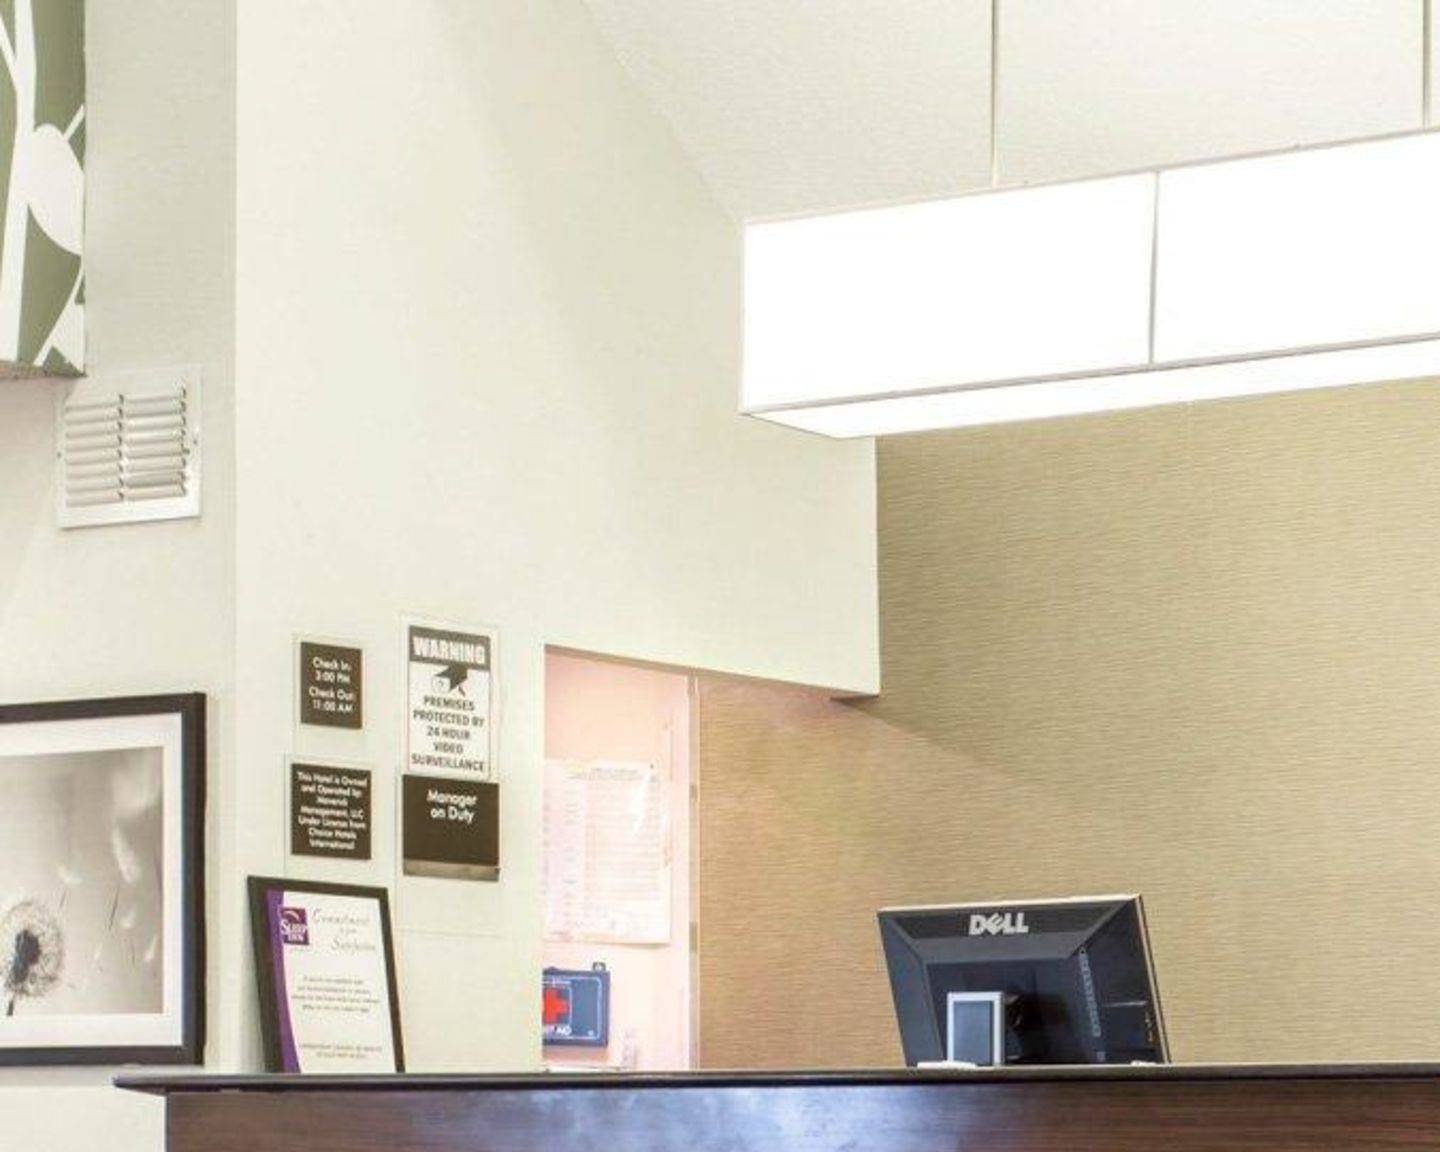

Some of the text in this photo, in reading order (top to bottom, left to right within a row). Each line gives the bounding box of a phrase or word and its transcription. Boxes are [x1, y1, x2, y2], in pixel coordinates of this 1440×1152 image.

[412, 634, 487, 665] WARNING
[423, 695, 476, 711] PREMISES
[413, 709, 485, 727] PROTECTED BY
[426, 725, 471, 739] 24 HOUR
[433, 741, 464, 755] VIDEO
[411, 753, 485, 772] SURVEILLANCE
[426, 789, 477, 808] Manager
[430, 806, 474, 824] on Duty
[969, 912, 1029, 936] DELL
